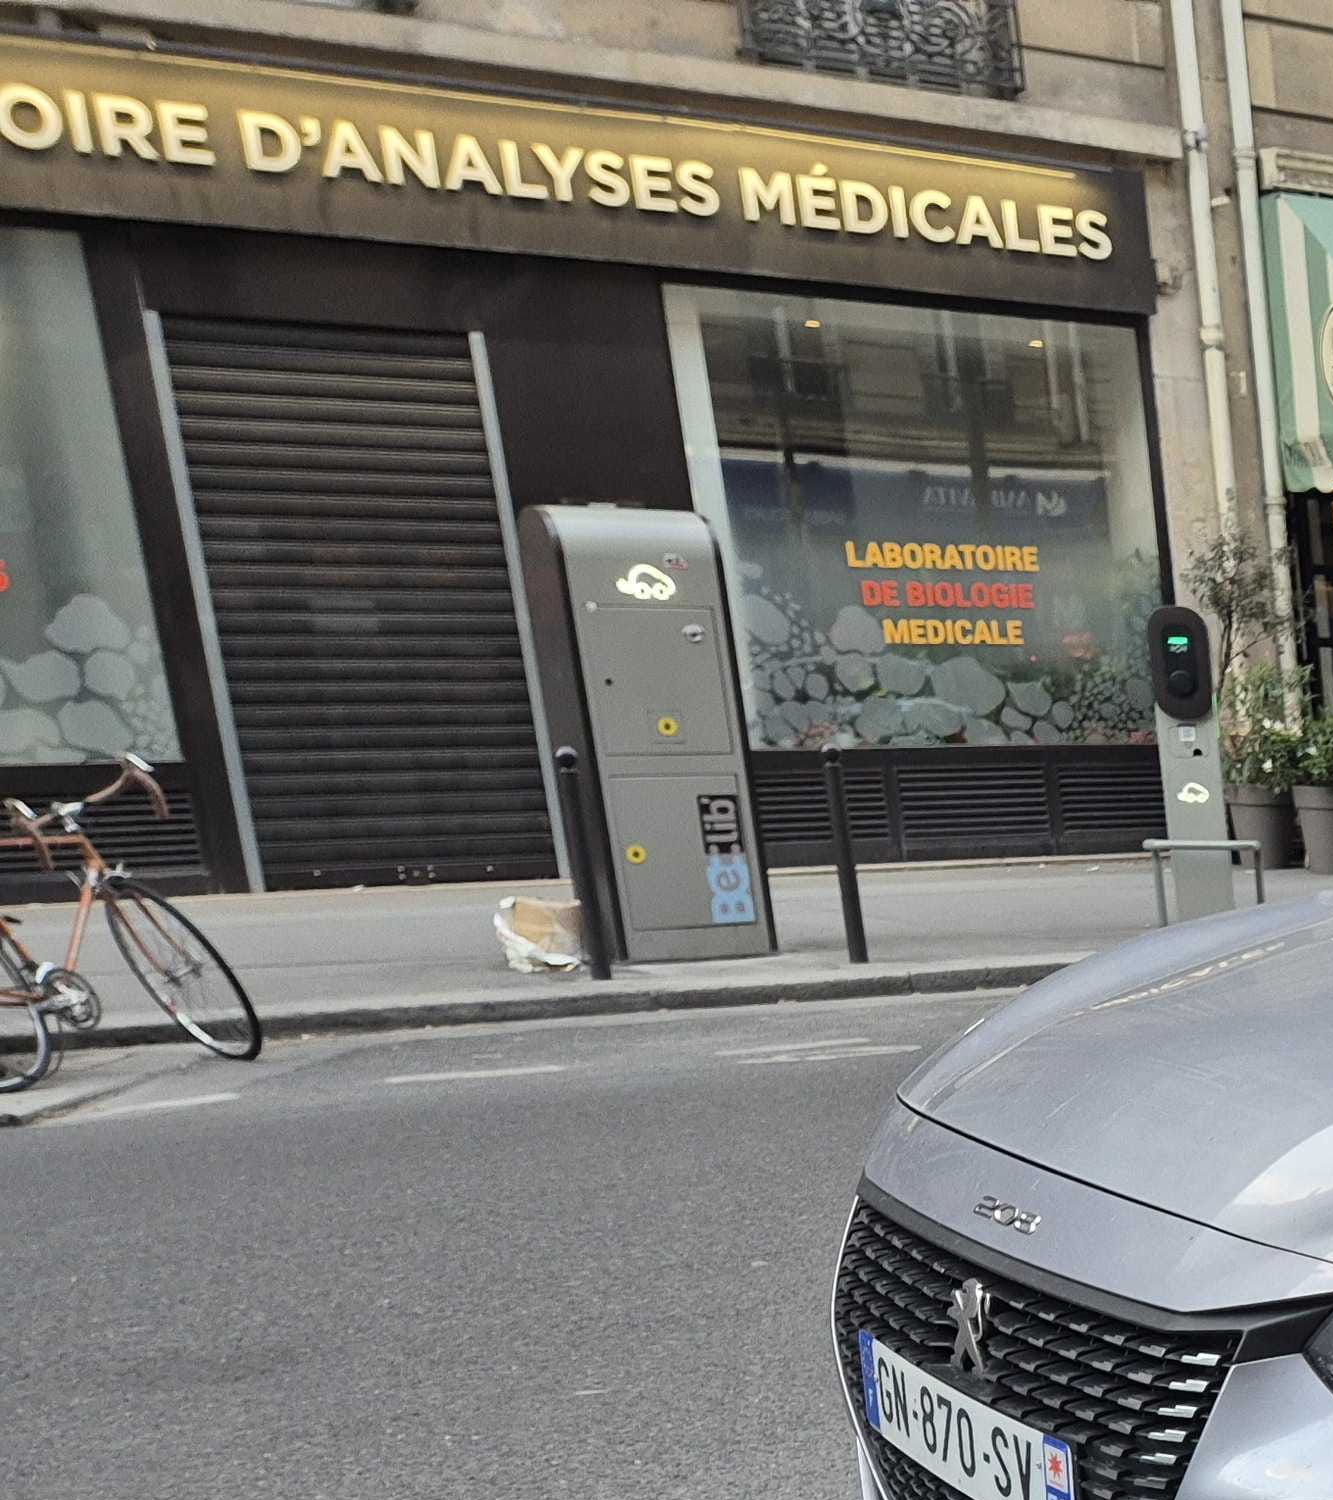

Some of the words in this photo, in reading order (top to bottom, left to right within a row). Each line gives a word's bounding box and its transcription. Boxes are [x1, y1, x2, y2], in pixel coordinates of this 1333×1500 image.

[0, 83, 216, 167] OIRE
[238, 109, 721, 218] D'ANALYSES
[738, 163, 1113, 261] MÉDICALES
[845, 541, 1040, 572] LABORATOIRE
[861, 580, 900, 606] DE
[906, 581, 1035, 609] BIOLOGIE
[882, 618, 1024, 646] MEDICALE
[973, 1195, 1041, 1235] 208
